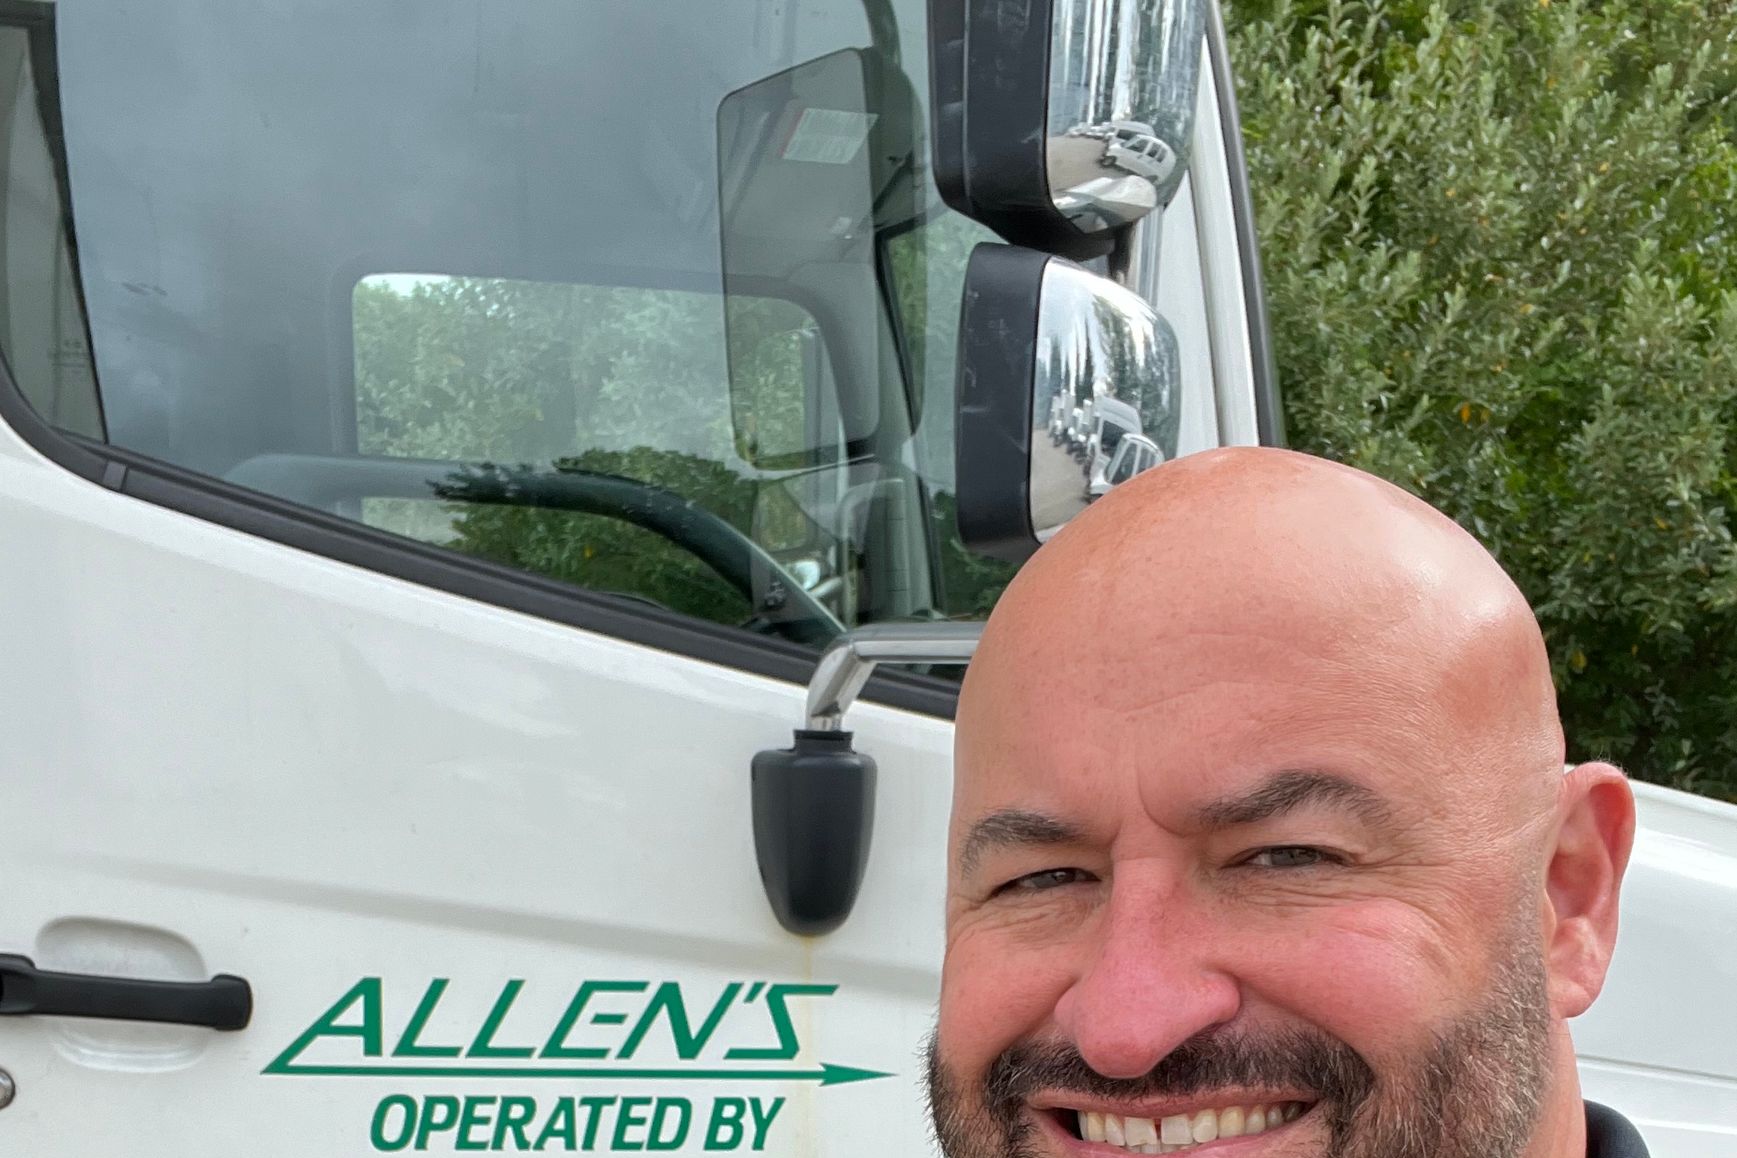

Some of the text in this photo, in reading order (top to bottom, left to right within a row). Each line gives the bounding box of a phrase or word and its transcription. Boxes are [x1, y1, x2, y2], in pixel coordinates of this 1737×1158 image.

[261, 976, 840, 1075] ALLEN'S
[369, 1094, 785, 1153] OPERATED BY
